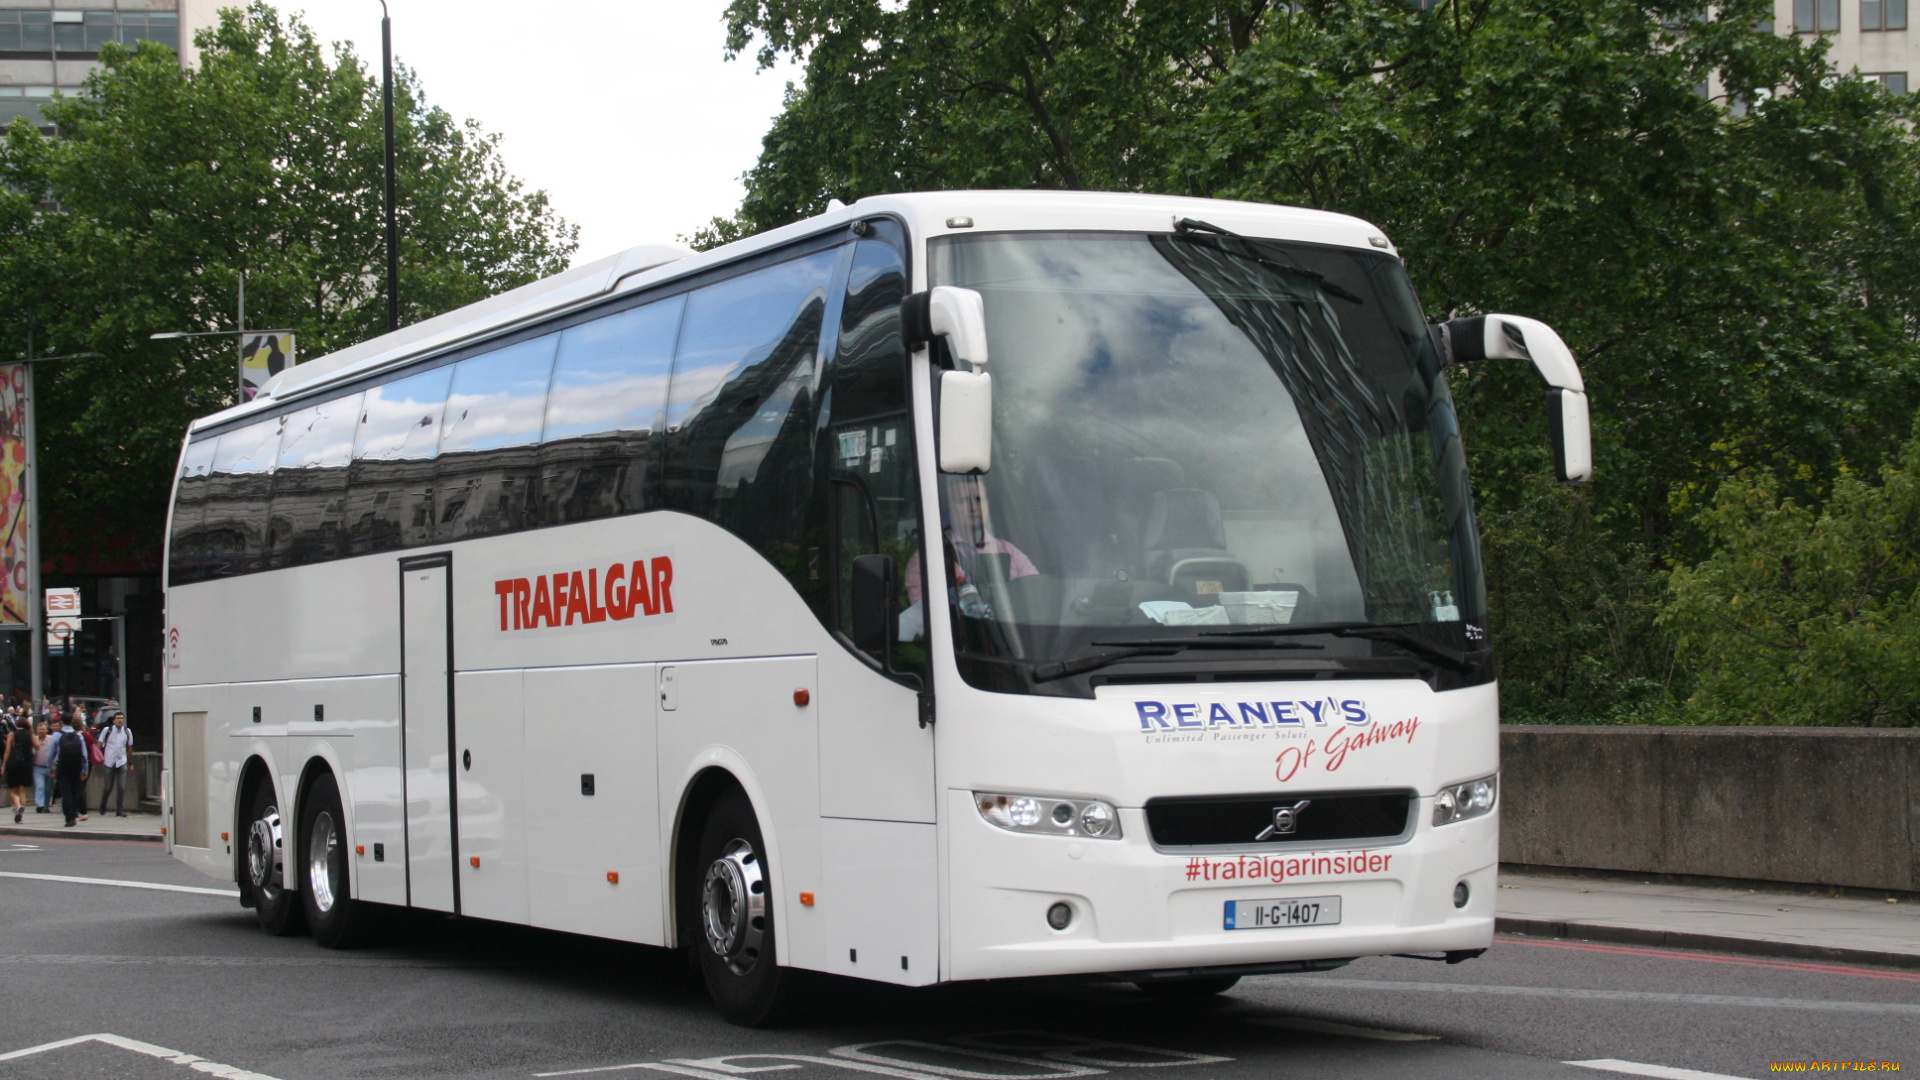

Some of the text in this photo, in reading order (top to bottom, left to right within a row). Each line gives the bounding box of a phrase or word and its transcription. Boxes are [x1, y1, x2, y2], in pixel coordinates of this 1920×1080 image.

[495, 556, 674, 632] TRAFALGAR
[1134, 697, 1369, 731] REANEY'S
[1145, 733, 1204, 744] Unlimited
[1213, 732, 1267, 742] Passenger
[1275, 716, 1422, 782] Of Galway
[1185, 850, 1393, 883] #trafalgarinsider
[1255, 903, 1320, 926] 11-G-1407
